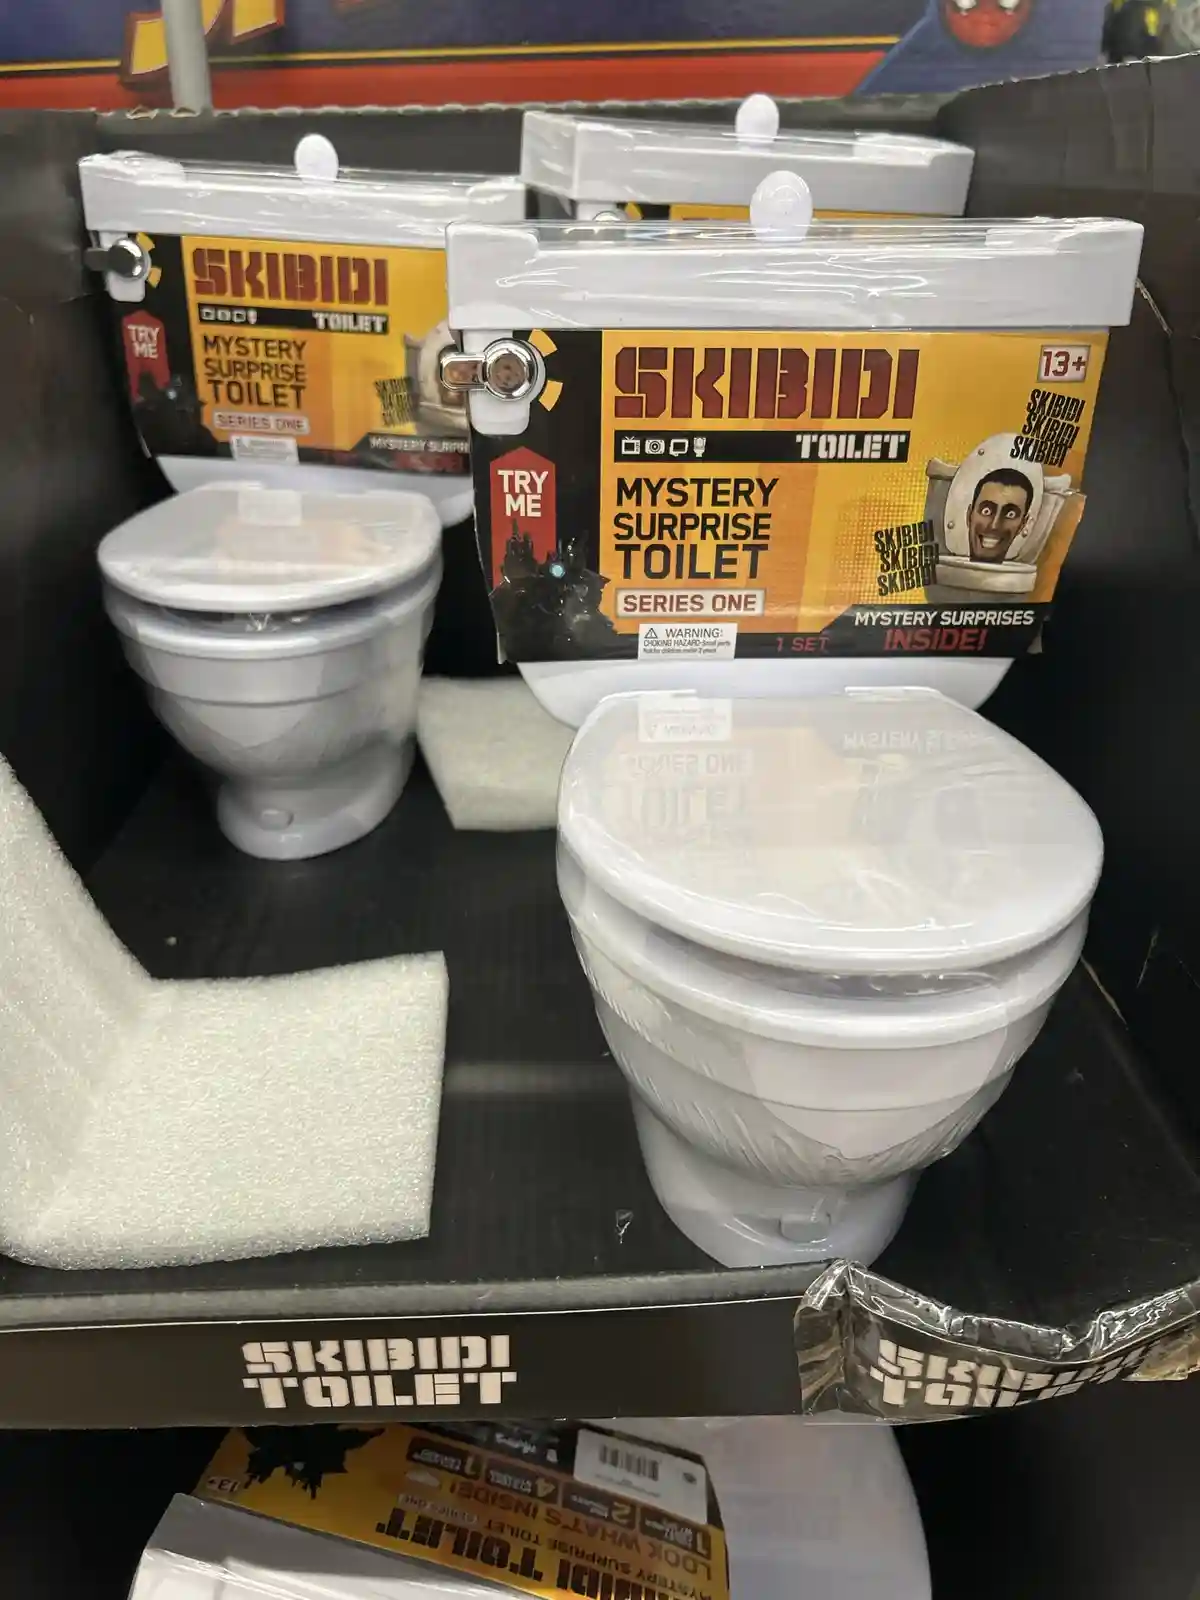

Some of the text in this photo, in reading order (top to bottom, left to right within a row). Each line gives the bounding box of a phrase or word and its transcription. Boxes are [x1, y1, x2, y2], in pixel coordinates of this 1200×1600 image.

[192, 248, 389, 306] SKIBIDI
[127, 324, 160, 343] TRY
[312, 311, 388, 333] TOILET
[134, 343, 158, 359] ME
[203, 335, 307, 361] MYSTERY
[203, 357, 306, 383] SURPRISE
[1042, 350, 1086, 377] 13+
[207, 379, 306, 409] TOILET
[614, 347, 920, 419] SKIBIDI
[1026, 388, 1086, 423] SKIBIDI
[215, 413, 271, 430] SERIES
[1021, 410, 1081, 449] SKIBIDI
[795, 434, 907, 459] TOILET
[1009, 435, 1069, 469] SKIBIDI
[497, 470, 549, 494] TRY
[616, 477, 779, 508] MYSTERY
[505, 494, 543, 517] ME
[613, 512, 773, 541] SURPRISE
[874, 520, 935, 553] SKIBIDI
[614, 543, 769, 579] TOILET
[880, 543, 940, 573] SKIBIDI
[877, 563, 938, 597] SKIBIDI
[623, 593, 757, 613] SERIES ONE
[854, 610, 1035, 626] MYSTERY SURPRISES
[643, 639, 672, 647] CHOKING
[665, 628, 724, 639] WARNING:
[792, 637, 830, 652] SET
[883, 628, 988, 651] INSIDE!
[242, 1335, 510, 1374] SKIBIDI
[242, 1371, 517, 1408] TOILET
[449, 1481, 539, 1519] INSIDE!
[375, 1507, 543, 1582] TOILET
[485, 1518, 542, 1546] TOILET
[551, 1537, 631, 1575] SURPRISE
[647, 1541, 712, 1581] LOOK
